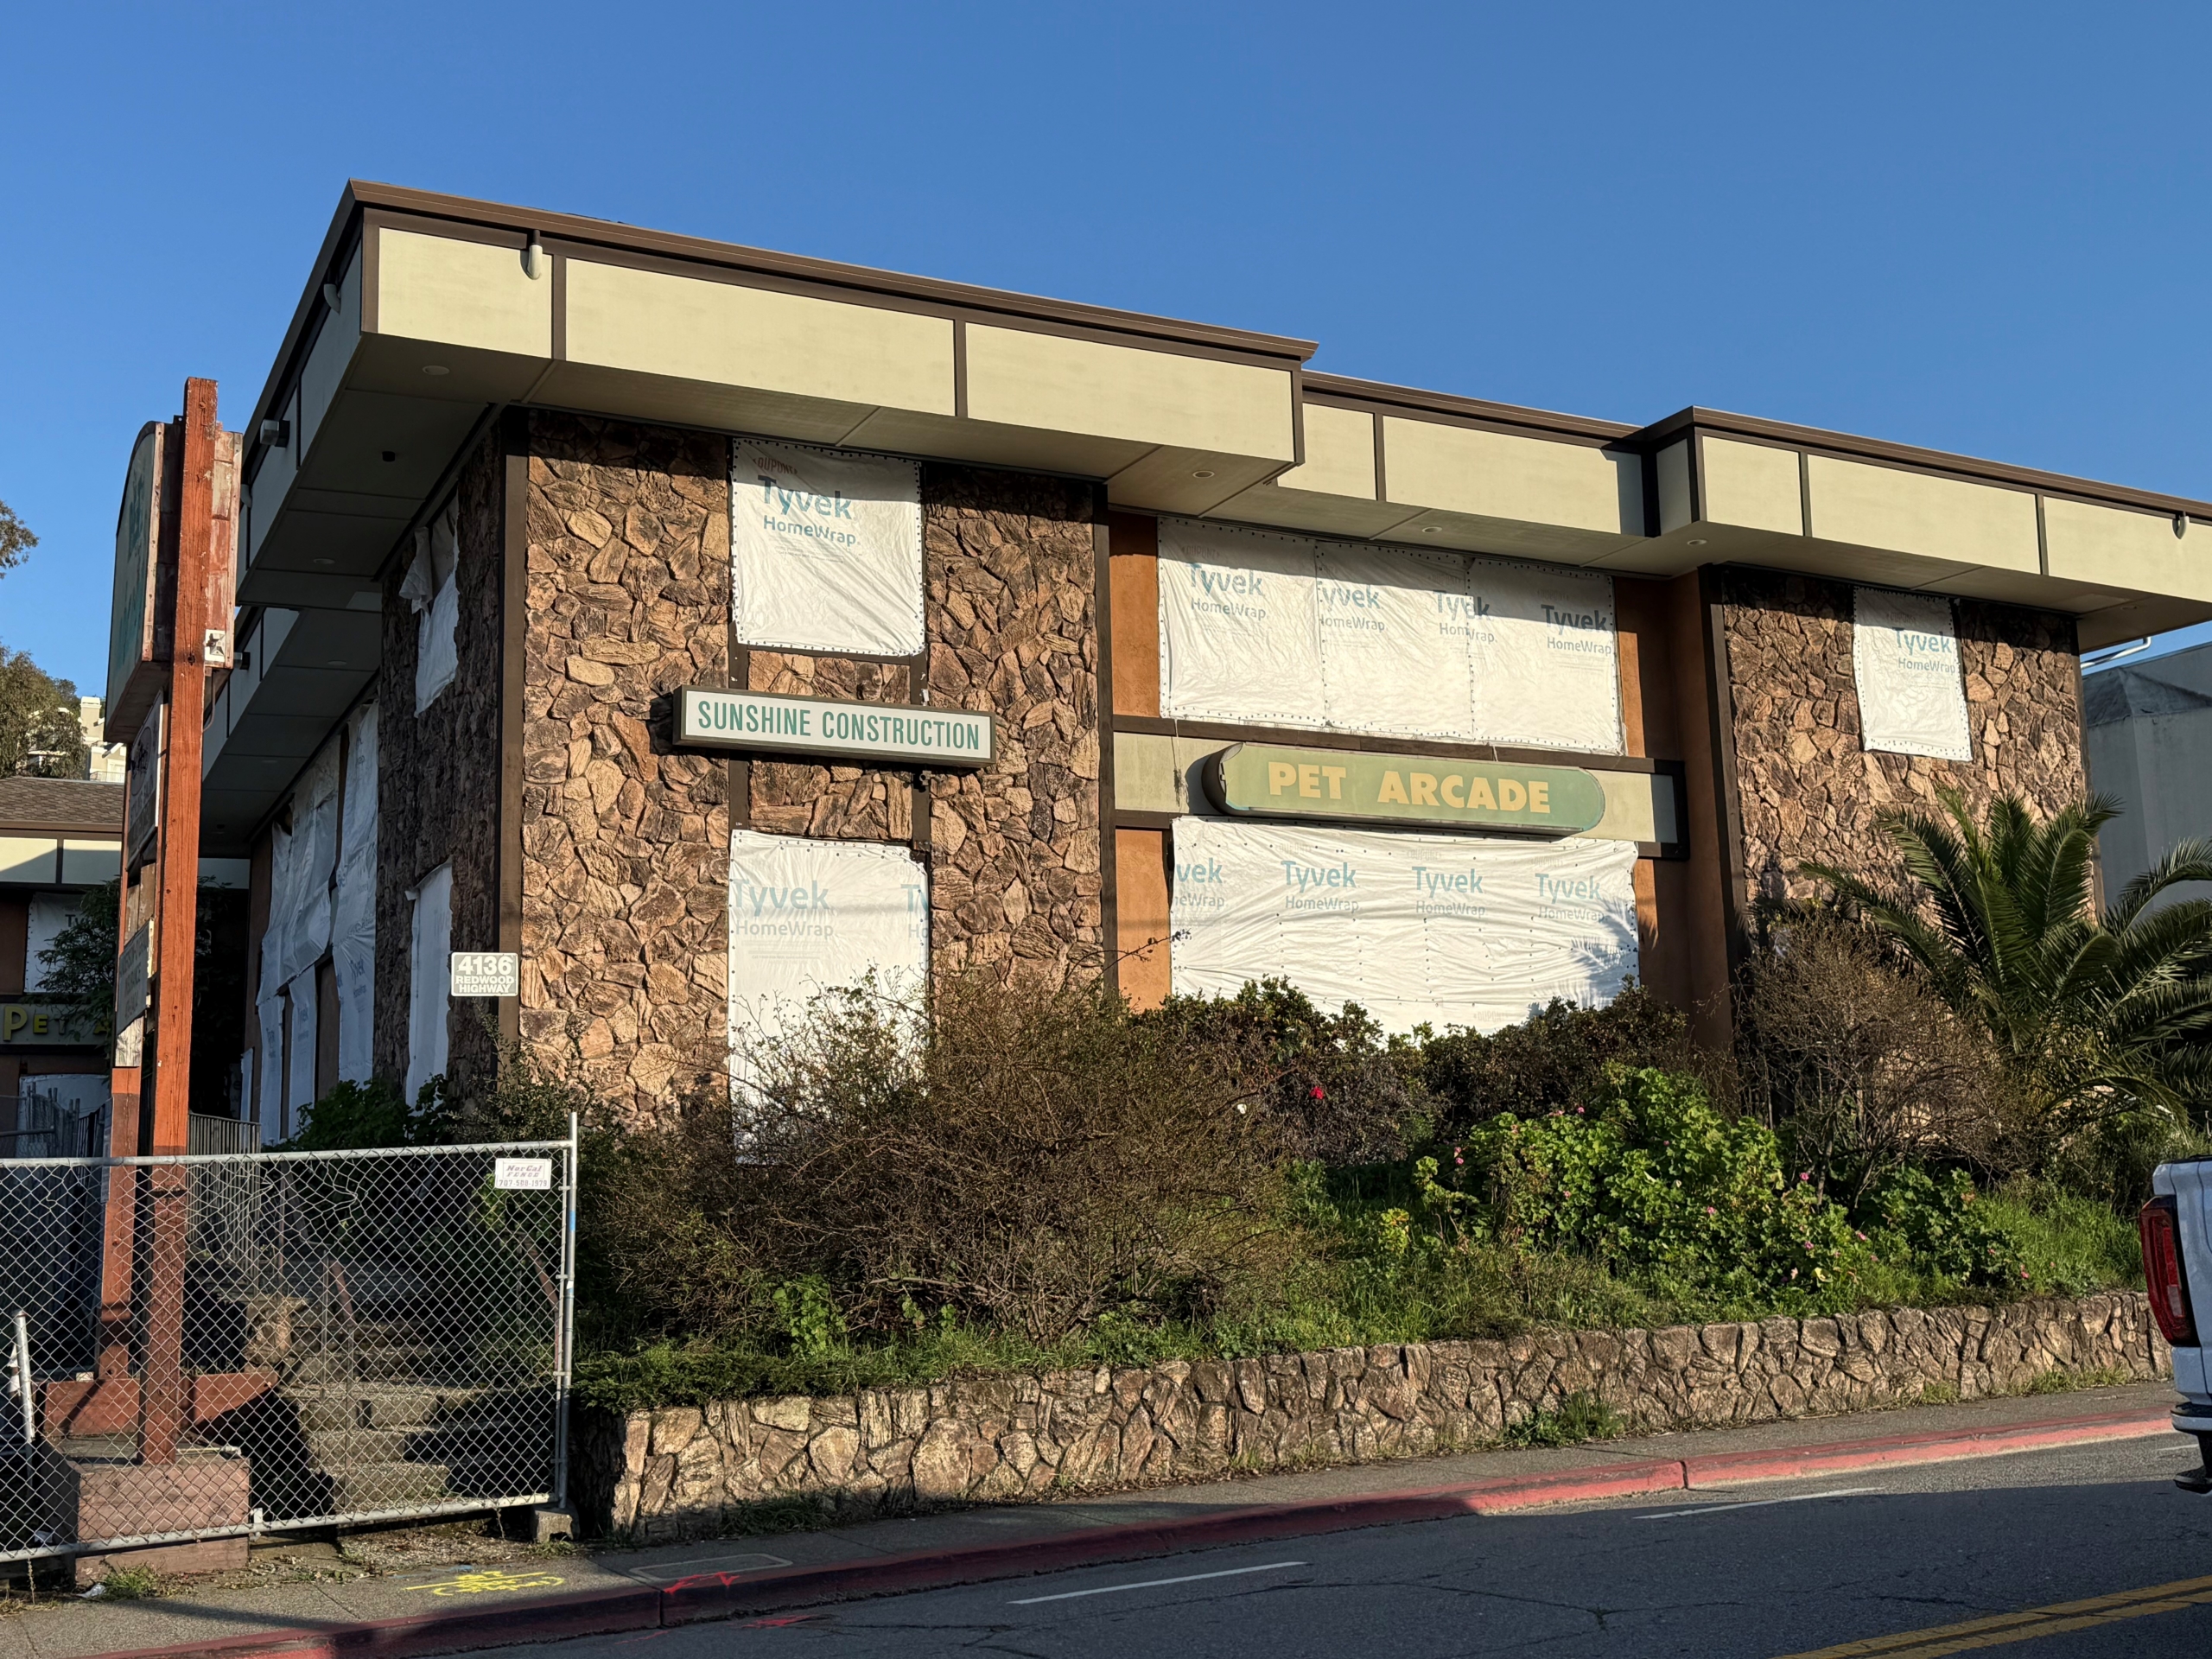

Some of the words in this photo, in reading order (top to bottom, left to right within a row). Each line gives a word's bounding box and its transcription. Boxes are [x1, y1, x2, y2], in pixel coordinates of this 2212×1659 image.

[758, 457, 793, 474] DUPONT
[758, 475, 852, 519] Tyvek
[764, 515, 856, 547] HomeWrap
[1186, 562, 1262, 595] Tyvek
[1191, 597, 1267, 621] HomeWrap
[1317, 581, 1381, 612] yvek
[1541, 604, 1607, 635] Tyvek
[1547, 637, 1611, 656] HomeWrap
[1892, 626, 1952, 655] Tyvek
[1898, 658, 1956, 676] HomeWrap
[698, 700, 811, 736] SUNSHINE
[823, 710, 979, 750] CONSTRUCTION
[1268, 761, 1346, 800] PET
[1377, 770, 1551, 814] ARCADE
[1281, 860, 1357, 893] Tyvek
[1412, 866, 1484, 898] Tyvek
[1535, 873, 1602, 903] Tyvek
[734, 879, 830, 917] Tyvek
[1285, 896, 1359, 913] HomeWrap
[1415, 900, 1485, 918] HomeWrap
[1538, 906, 1605, 923] HomeWrap
[735, 920, 834, 939] HomeWrap
[457, 955, 514, 975] 4136
[455, 976, 514, 985] REDWOOD
[459, 984, 512, 994] HIGHWAY
